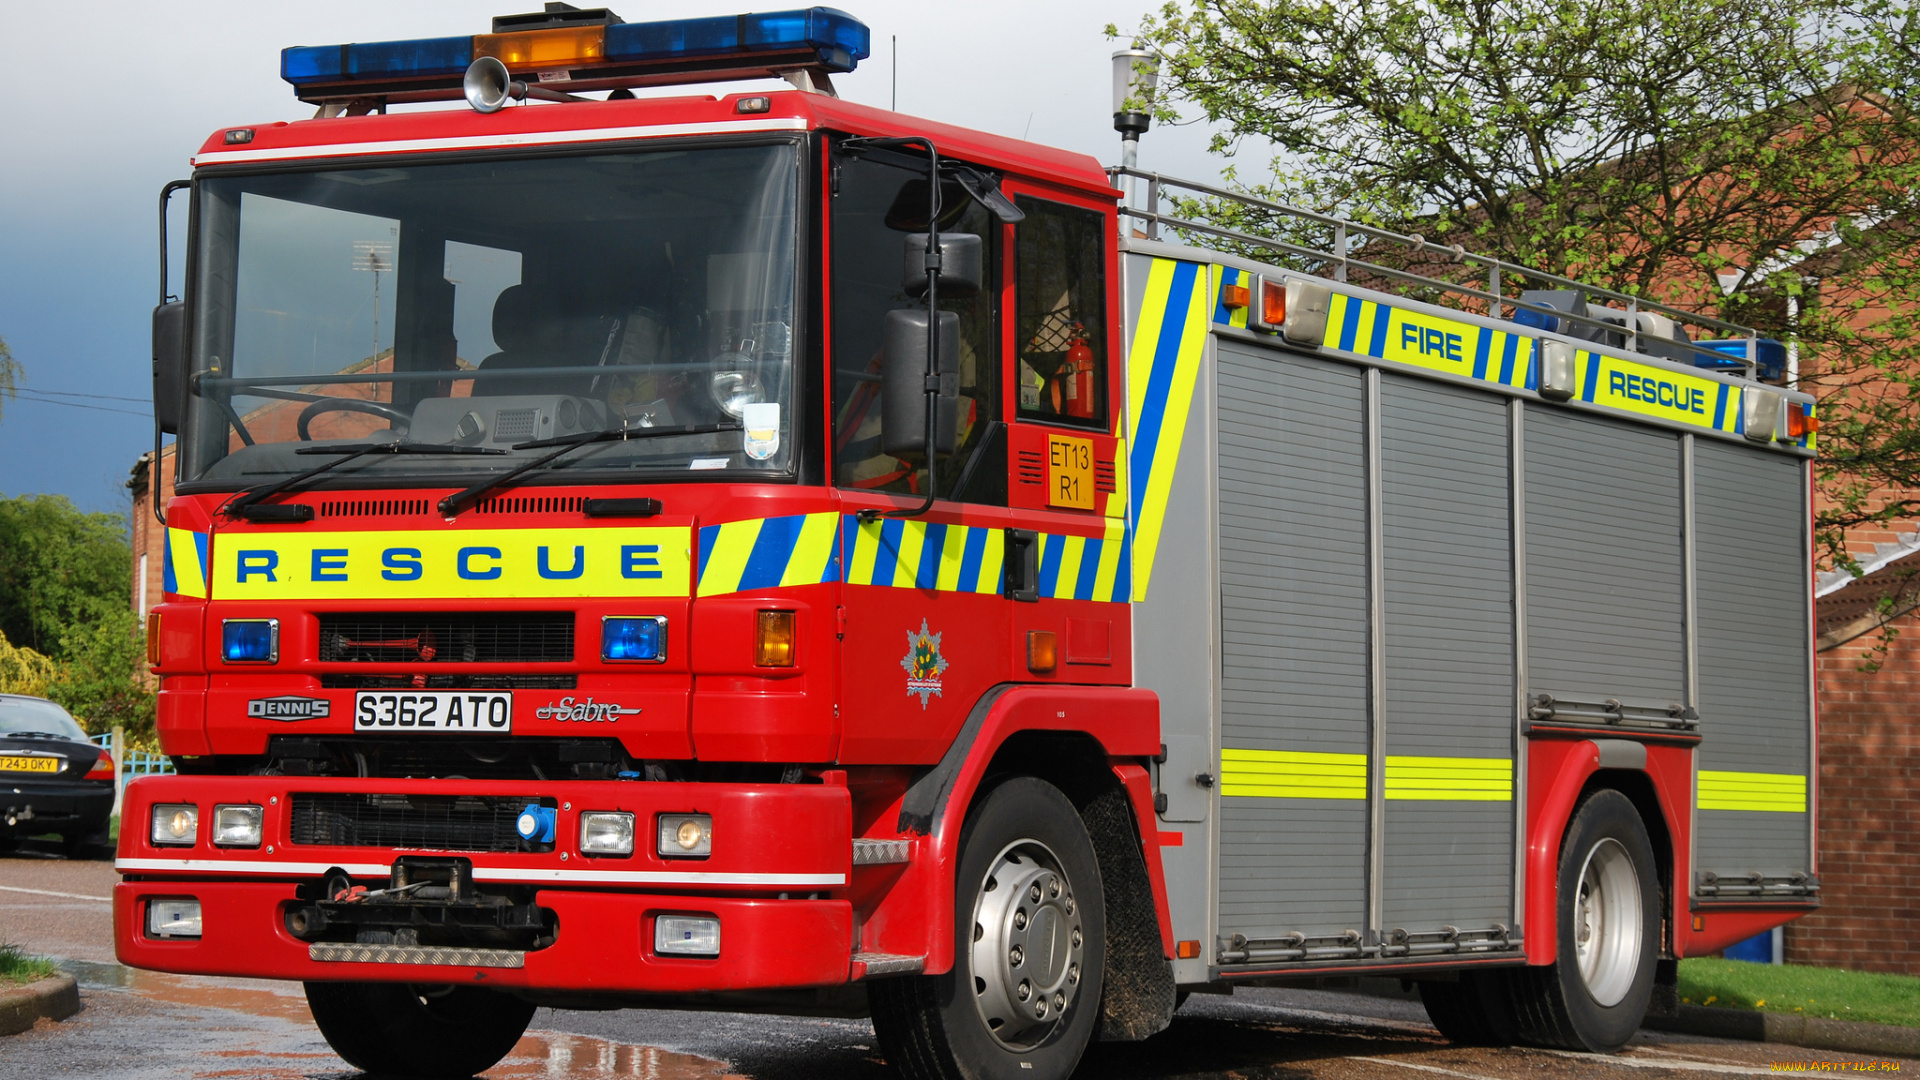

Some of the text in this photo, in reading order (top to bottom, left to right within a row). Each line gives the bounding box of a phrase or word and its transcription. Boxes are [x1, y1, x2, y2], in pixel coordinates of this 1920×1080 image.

[1401, 322, 1704, 414] FIRE RESCUE
[1051, 441, 1089, 470] ET13
[1060, 475, 1079, 501] R1
[236, 544, 663, 583] RESCUE
[247, 700, 330, 716] DENNIS
[358, 696, 508, 727] S362 ATO
[555, 696, 622, 722] Sabre
[31, 759, 53, 770] OKY
